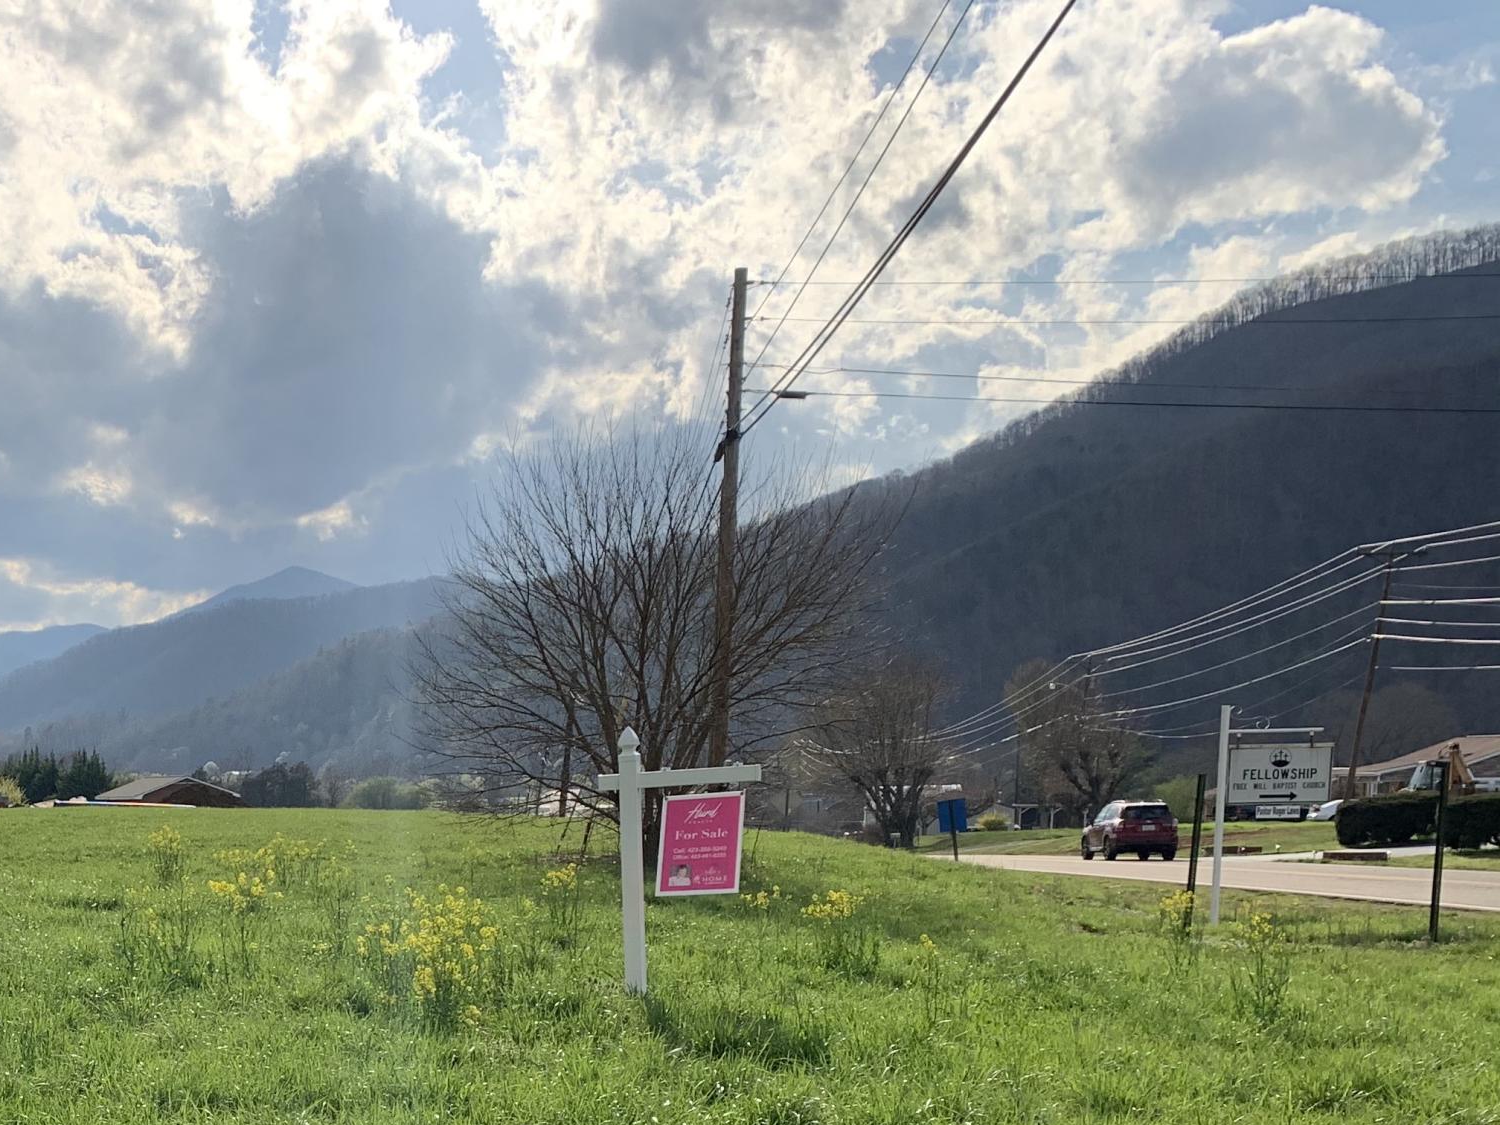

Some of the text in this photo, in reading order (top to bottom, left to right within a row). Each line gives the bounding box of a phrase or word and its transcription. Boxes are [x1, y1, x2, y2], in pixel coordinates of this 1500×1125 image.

[1242, 768, 1318, 780] FELLOWSHIP
[1272, 782, 1297, 790] BAPTIST
[1302, 781, 1326, 790] CHURCH
[675, 828, 729, 840] For Sale
